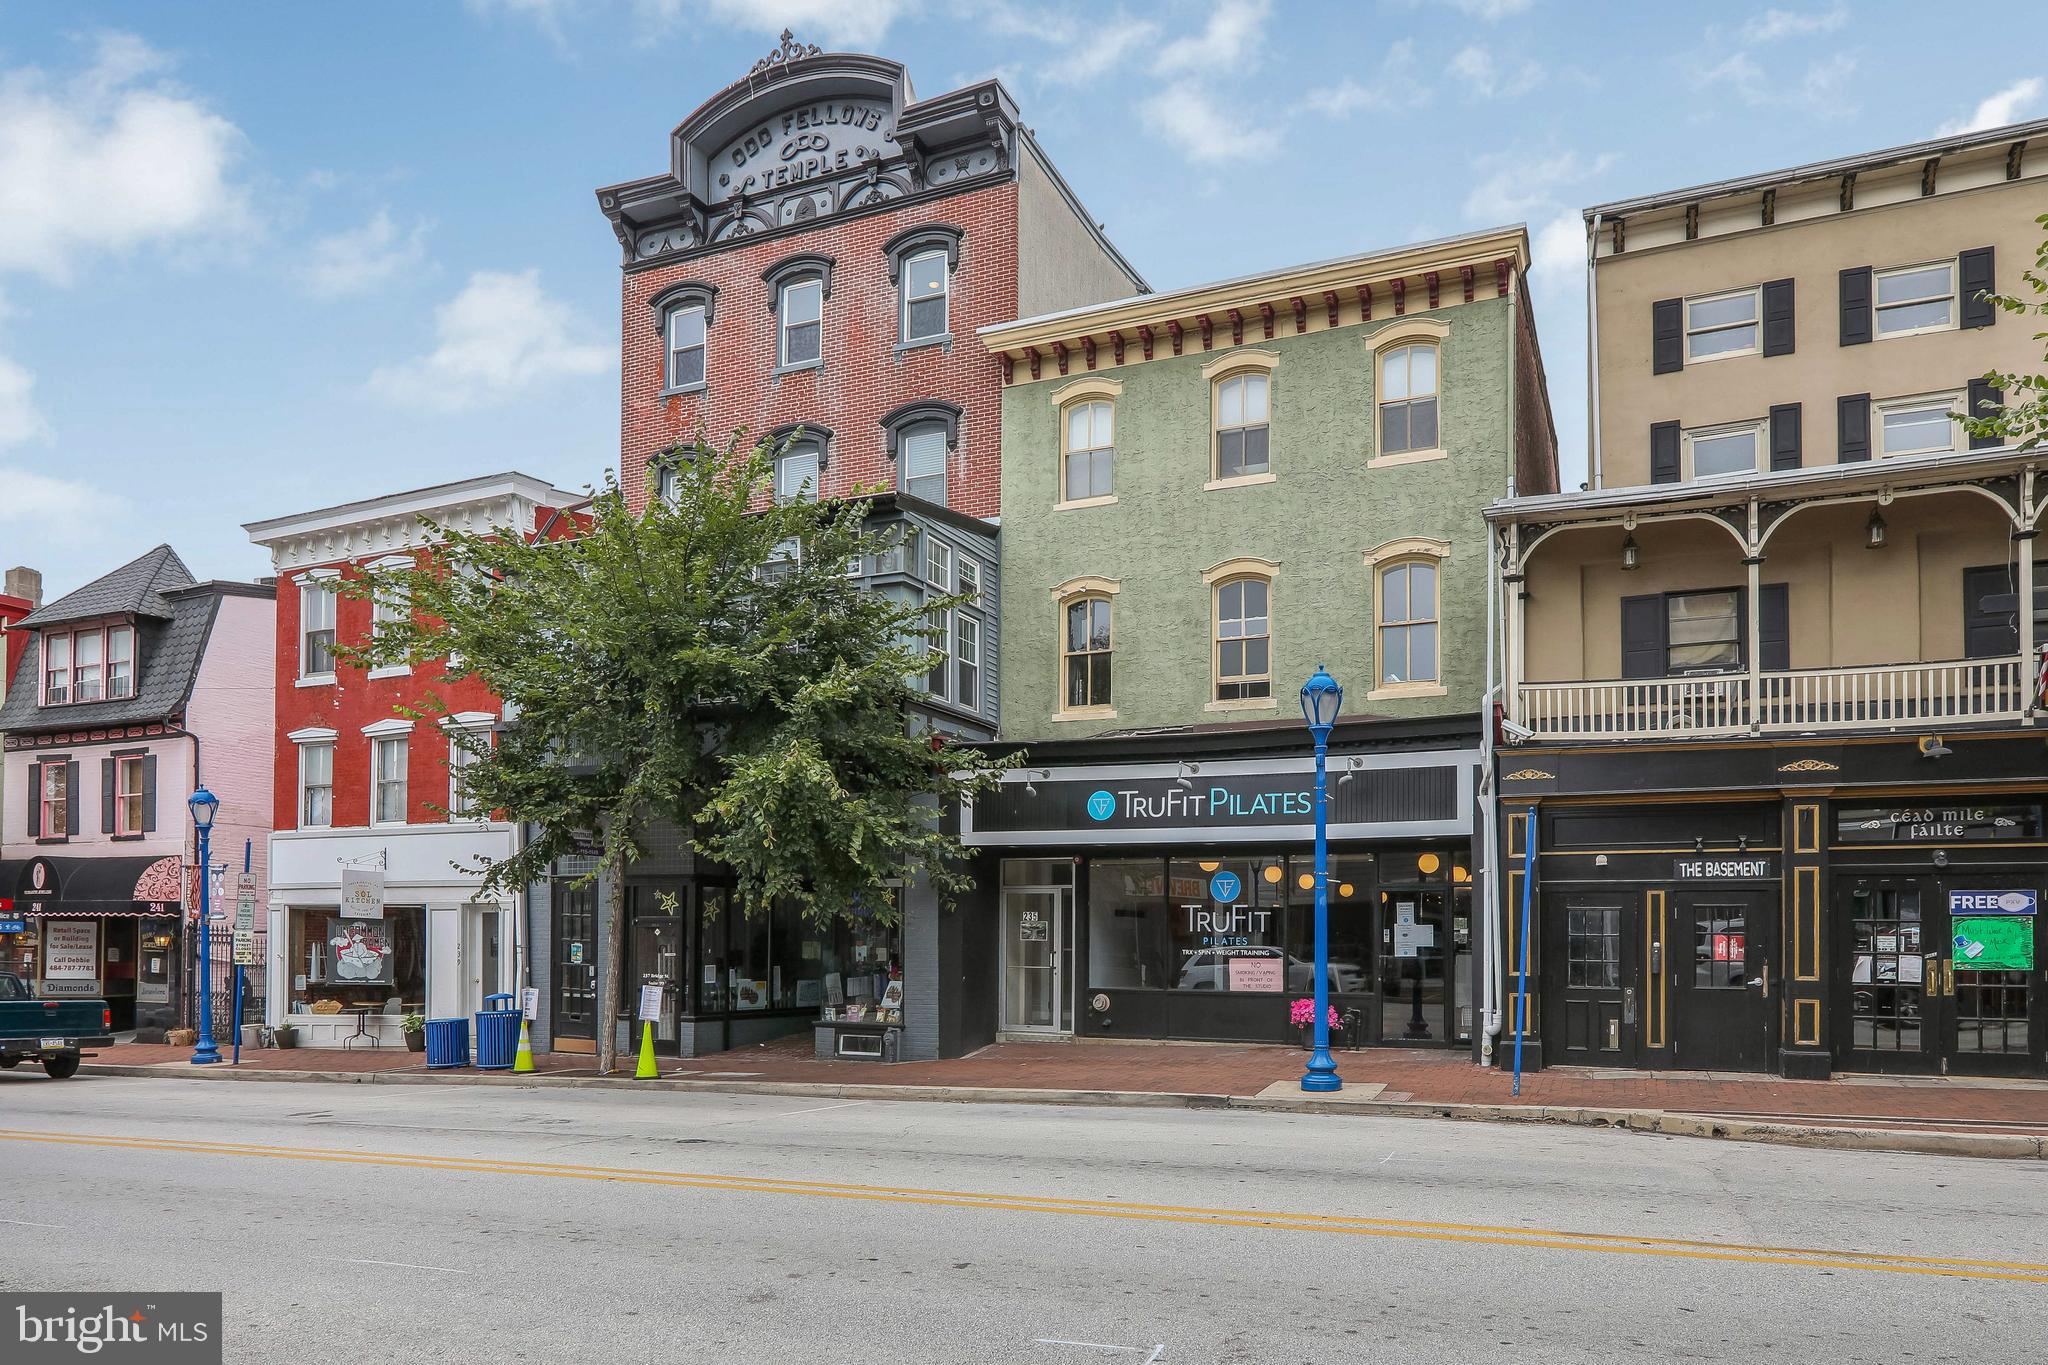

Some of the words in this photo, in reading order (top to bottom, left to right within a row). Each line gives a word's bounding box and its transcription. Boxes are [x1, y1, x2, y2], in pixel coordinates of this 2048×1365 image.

[731, 127, 772, 167] ODD
[781, 104, 882, 135] FELLOWS
[761, 149, 848, 189] TEMPLE
[1679, 861, 1703, 878] THE
[1705, 860, 1766, 877] BASEMENT
[345, 896, 381, 904] KITCHEN
[1951, 895, 1998, 909] FREE
[149, 902, 165, 912] 241
[1023, 911, 1038, 921] 235
[62, 935, 89, 943] Building
[1203, 937, 1248, 945] PILATES
[1251, 961, 1261, 969] NO
[47, 983, 94, 992] Diamonds
